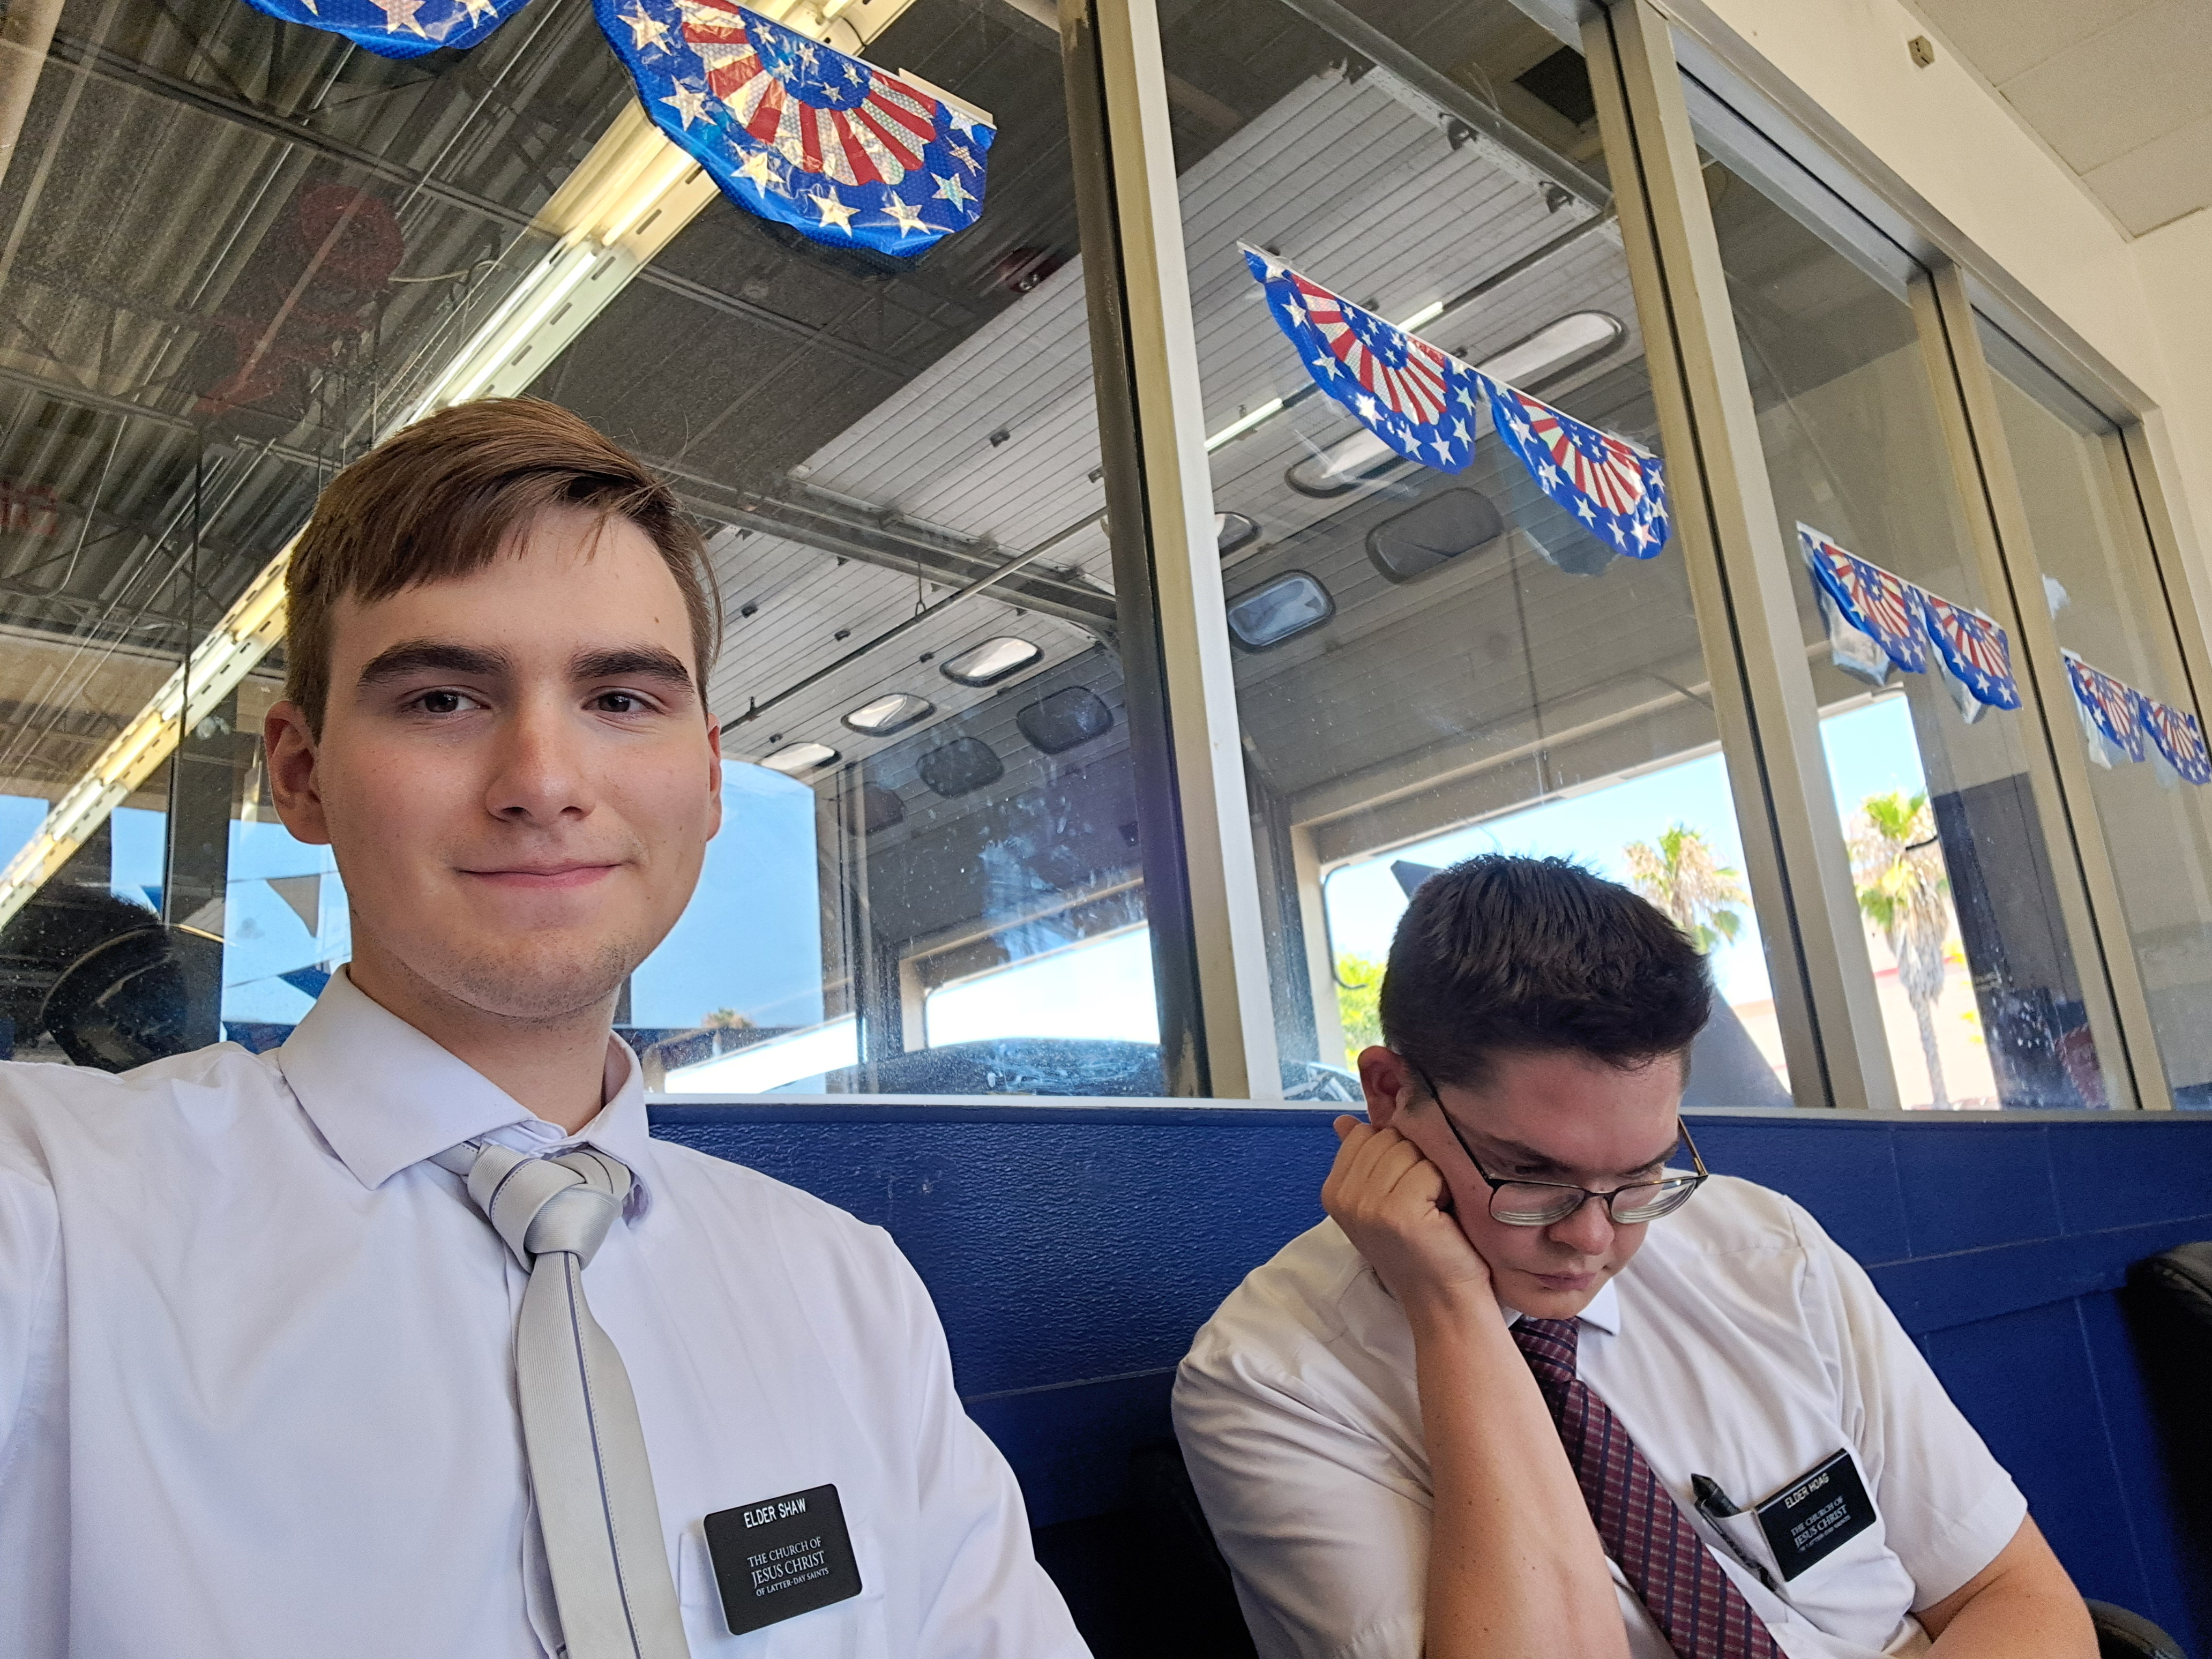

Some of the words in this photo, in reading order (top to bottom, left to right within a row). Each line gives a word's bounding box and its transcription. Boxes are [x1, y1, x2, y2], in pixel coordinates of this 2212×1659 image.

[1784, 1486, 1810, 1508] ELDER
[744, 1506, 776, 1528] ELDER
[778, 1498, 806, 1518] SHAW
[1794, 1526, 1817, 1548] JESUS
[1817, 1504, 1847, 1531] CHRIST
[748, 1553, 768, 1567] THE
[769, 1541, 808, 1560] CHURCH
[810, 1537, 821, 1548] OF
[751, 1564, 783, 1588] JESUS
[784, 1551, 824, 1574] CHRIST
[756, 1588, 765, 1596] OF
[767, 1574, 807, 1593] LATTER-DAY
[806, 1567, 829, 1580] SAINTS
